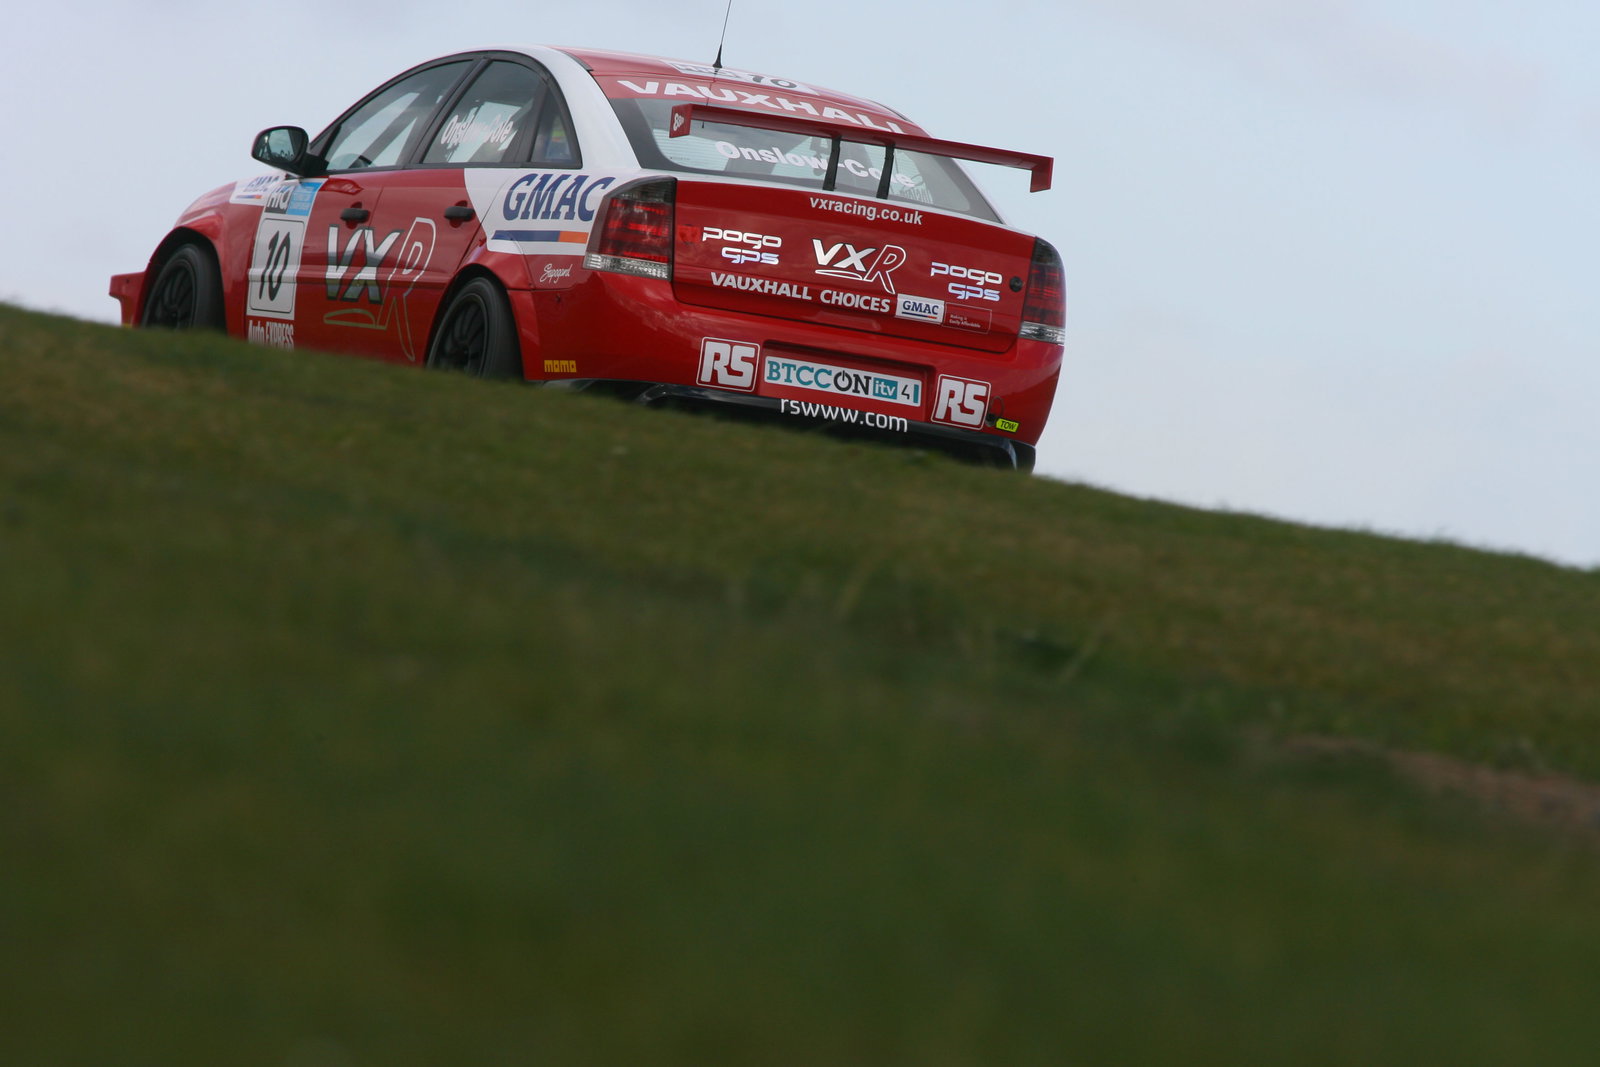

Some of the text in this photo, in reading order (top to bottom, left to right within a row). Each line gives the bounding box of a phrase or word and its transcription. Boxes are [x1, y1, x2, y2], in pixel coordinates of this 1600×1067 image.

[617, 80, 907, 135] VAUXHALL
[714, 140, 916, 188] Onslow-Coe
[502, 173, 616, 222] GMAC
[810, 196, 924, 226] vxracing.co.uk
[702, 226, 782, 249] pogo
[721, 246, 780, 265] gps
[258, 230, 291, 301] 10
[812, 238, 907, 295] VXR
[930, 261, 1003, 286] pogo
[710, 271, 891, 314] VAUXHALL CHOICES
[902, 300, 940, 316] GMAC
[948, 283, 1001, 301] gps
[700, 340, 756, 389] RS
[780, 398, 908, 433] rswww.com
[935, 378, 990, 428] RS
[1000, 420, 1018, 432] TOW
